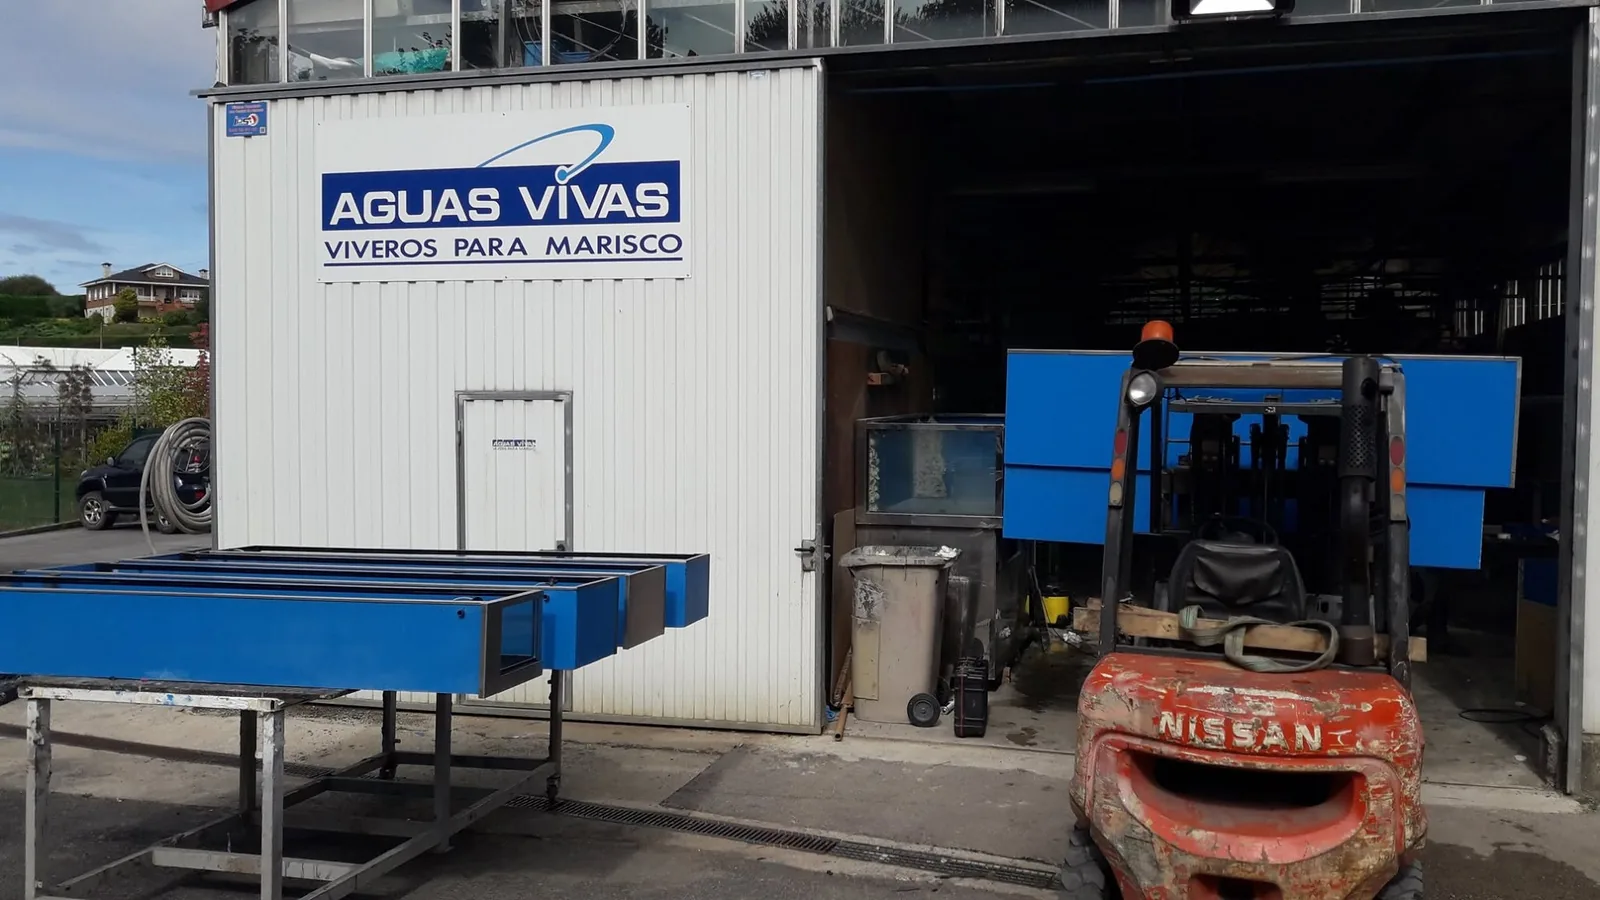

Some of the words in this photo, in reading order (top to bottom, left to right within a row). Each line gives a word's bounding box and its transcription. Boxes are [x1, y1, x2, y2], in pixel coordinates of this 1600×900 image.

[329, 187, 501, 226] AGUAS
[518, 182, 670, 220] VIVAS
[324, 238, 438, 260] VIVEROS
[454, 237, 528, 257] PARA
[545, 233, 684, 256] MARISCO
[1158, 711, 1322, 751] NISSAN
